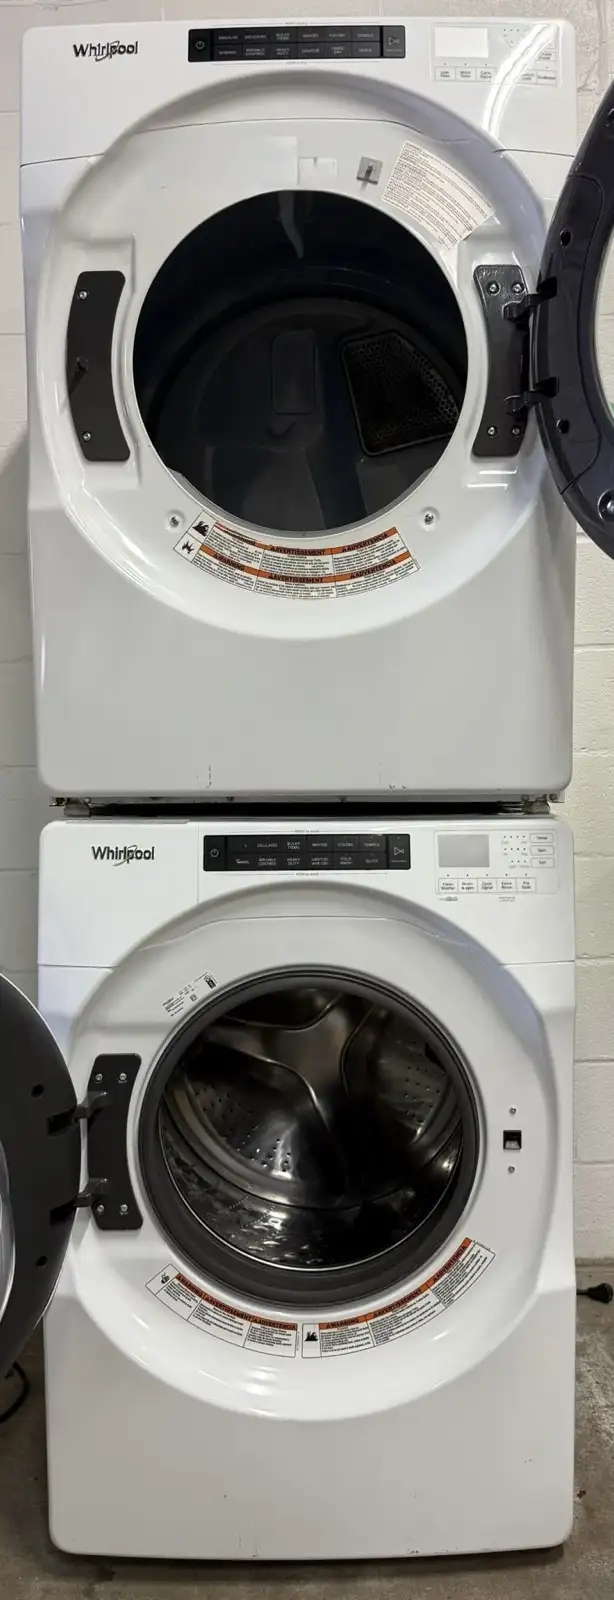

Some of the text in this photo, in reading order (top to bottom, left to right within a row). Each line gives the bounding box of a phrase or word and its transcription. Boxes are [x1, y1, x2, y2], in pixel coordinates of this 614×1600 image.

[73, 40, 138, 62] Whirlpool
[346, 532, 389, 551] ADVERTENCIA
[355, 559, 396, 578] ADVERTENCIA
[91, 845, 155, 867] Whirlpool
